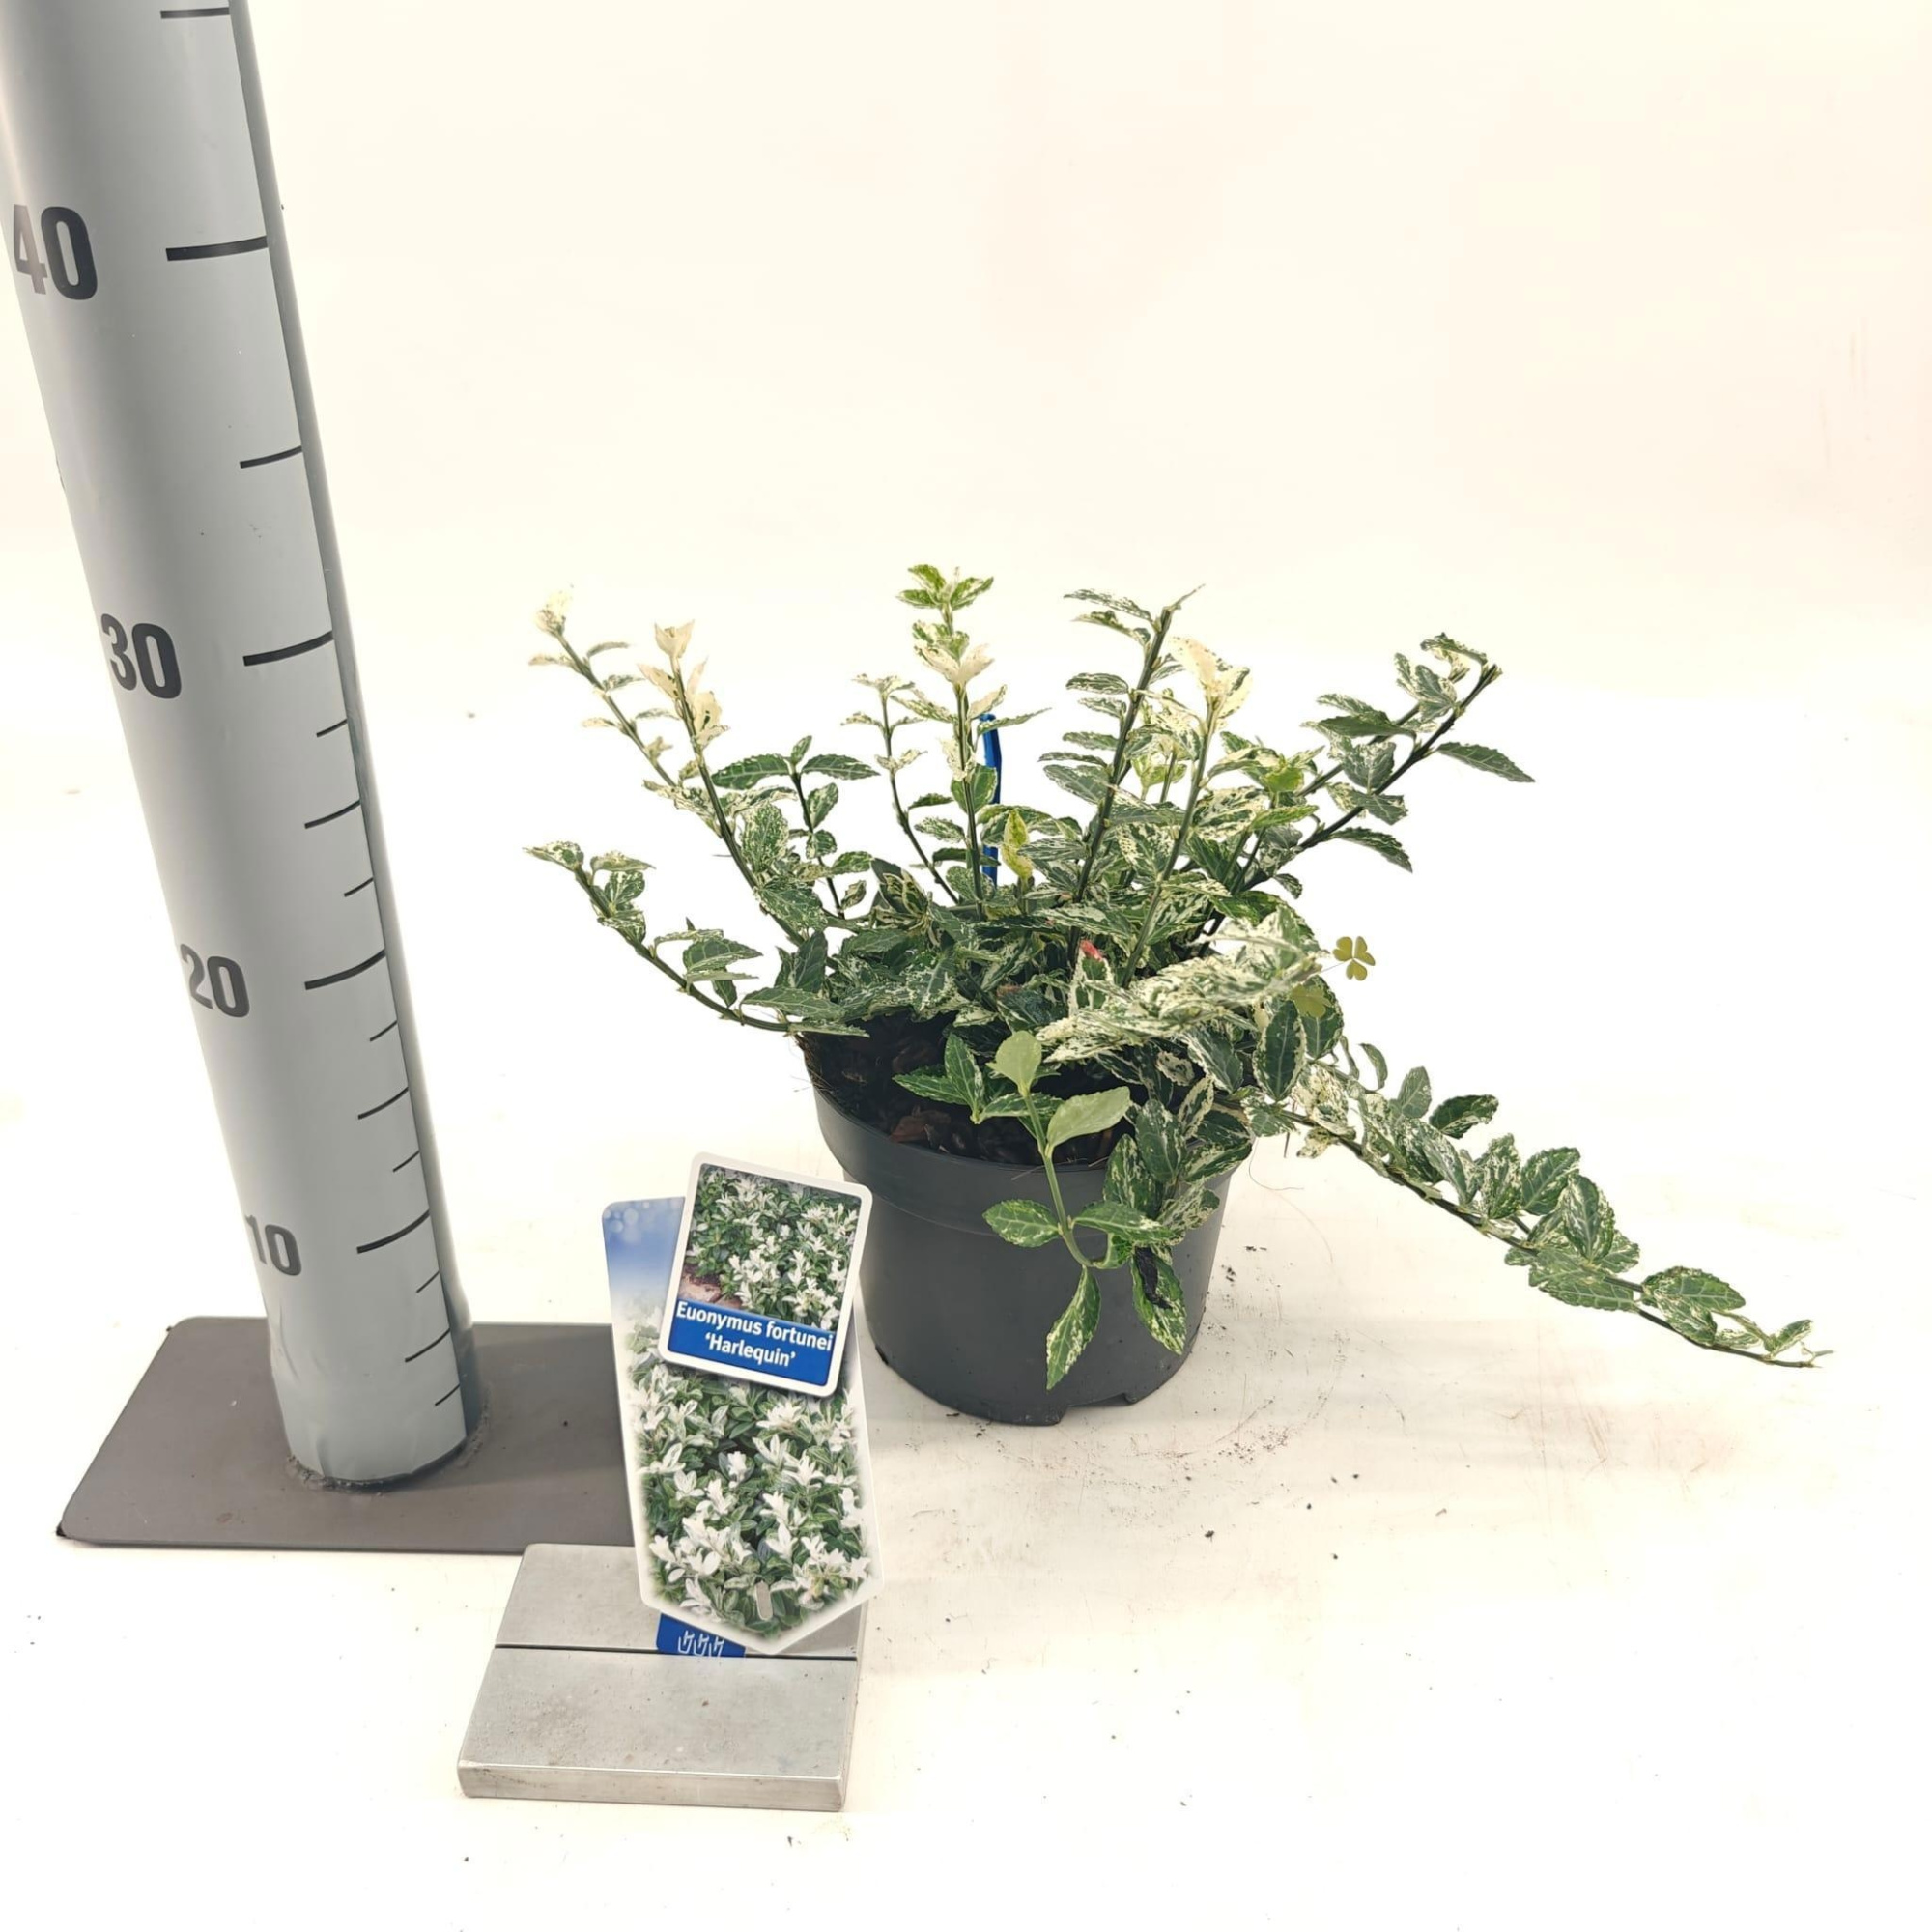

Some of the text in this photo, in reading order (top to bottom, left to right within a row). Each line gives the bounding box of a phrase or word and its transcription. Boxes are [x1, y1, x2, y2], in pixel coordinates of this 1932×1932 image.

[13, 204, 98, 300] 40
[100, 613, 182, 700] 30
[181, 944, 250, 1018] 20
[245, 1215, 301, 1276] 10
[676, 1301, 834, 1351] Euonymus fortunei
